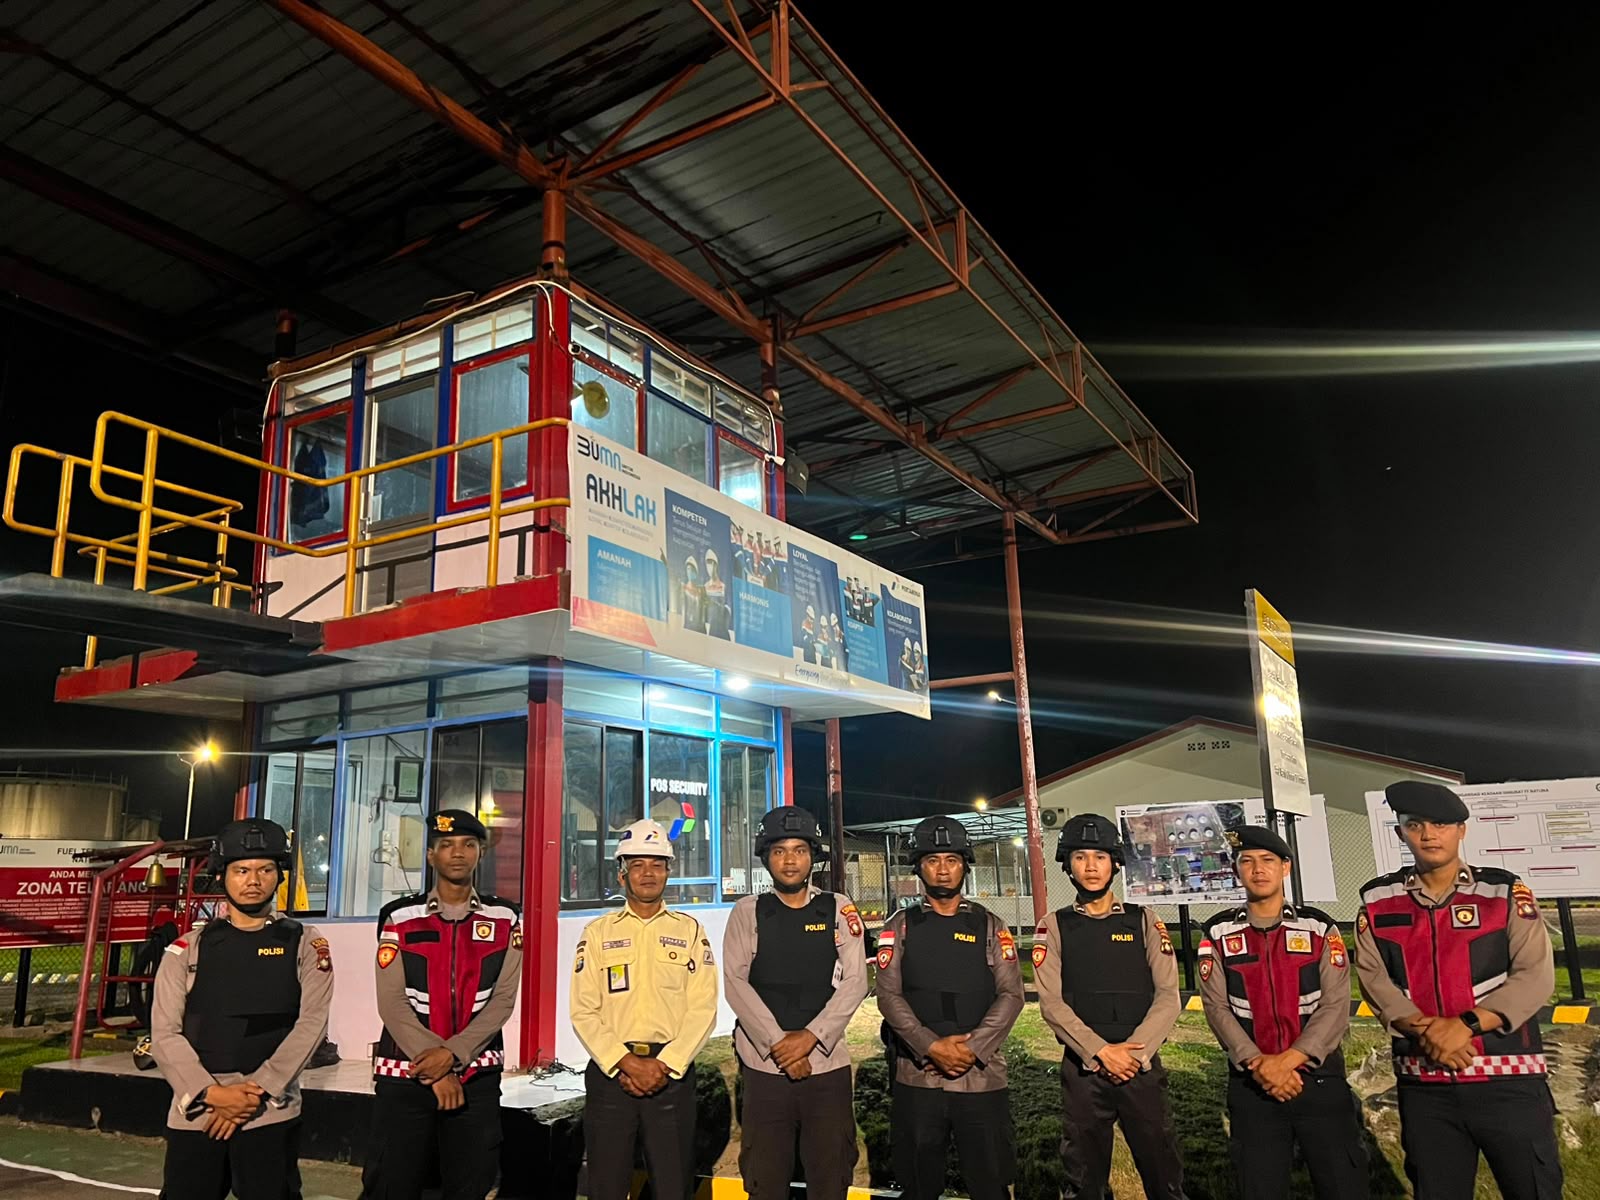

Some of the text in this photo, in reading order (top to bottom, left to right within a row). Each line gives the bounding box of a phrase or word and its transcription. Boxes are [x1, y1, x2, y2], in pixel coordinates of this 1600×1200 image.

[586, 473, 657, 527] AKHLAK
[672, 504, 707, 527] KOMPETEN
[597, 549, 632, 568] AMANAH
[792, 548, 809, 562] LOYAL
[739, 591, 769, 608] HARMONIS
[650, 778, 708, 797] POS SECURITY
[49, 870, 76, 879] ANDA
[16, 881, 63, 896] ZONA
[805, 923, 826, 931] POLISI
[954, 932, 976, 943] POLISI
[1111, 934, 1134, 942] POLISI
[258, 947, 284, 956] POLISI
